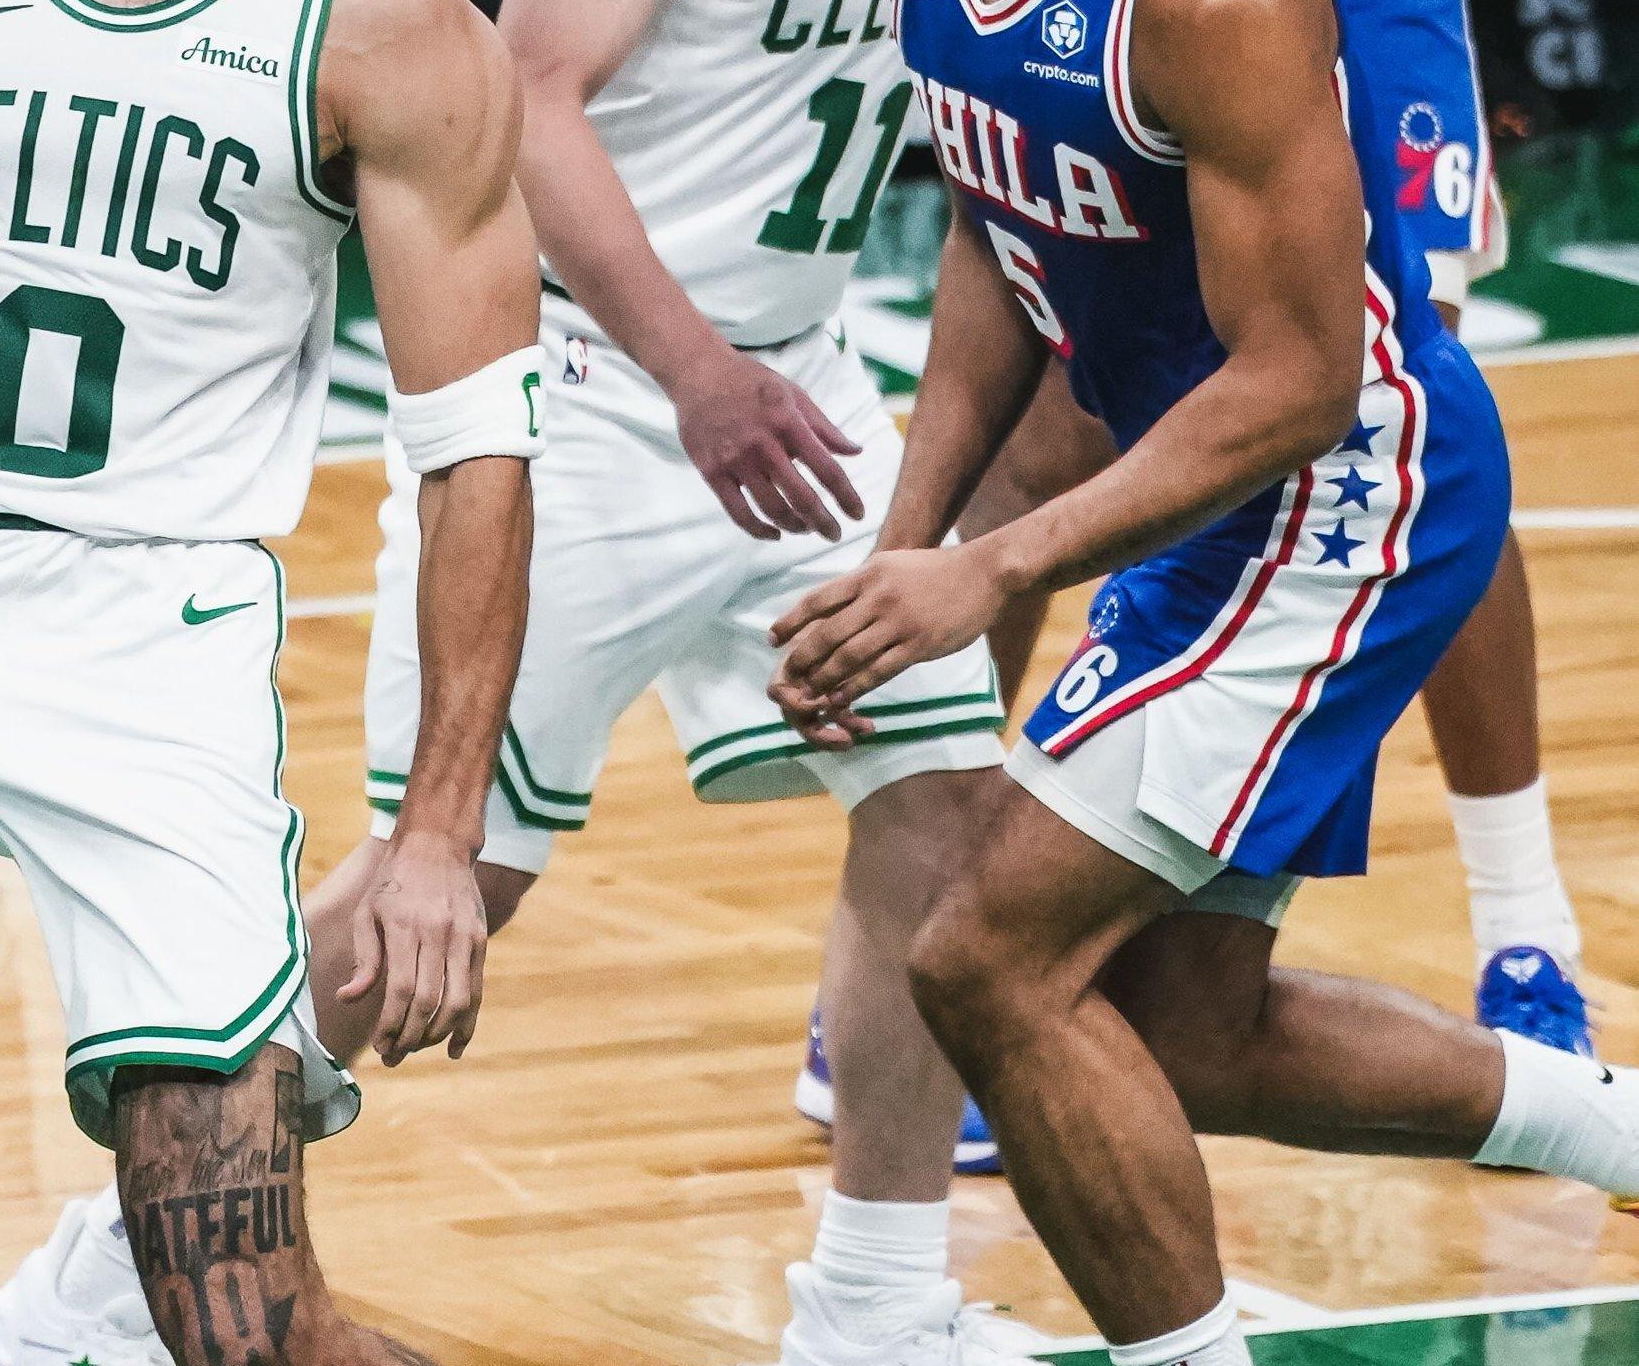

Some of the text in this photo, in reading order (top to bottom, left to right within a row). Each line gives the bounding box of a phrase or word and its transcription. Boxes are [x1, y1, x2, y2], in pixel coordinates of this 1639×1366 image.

[181, 37, 279, 78] Amica
[1023, 59, 1100, 88] crypto.com
[1396, 139, 1472, 219] 76
[984, 220, 1074, 359] 5
[1056, 637, 1119, 714] 6
[130, 1184, 297, 1277] ATEFUL
